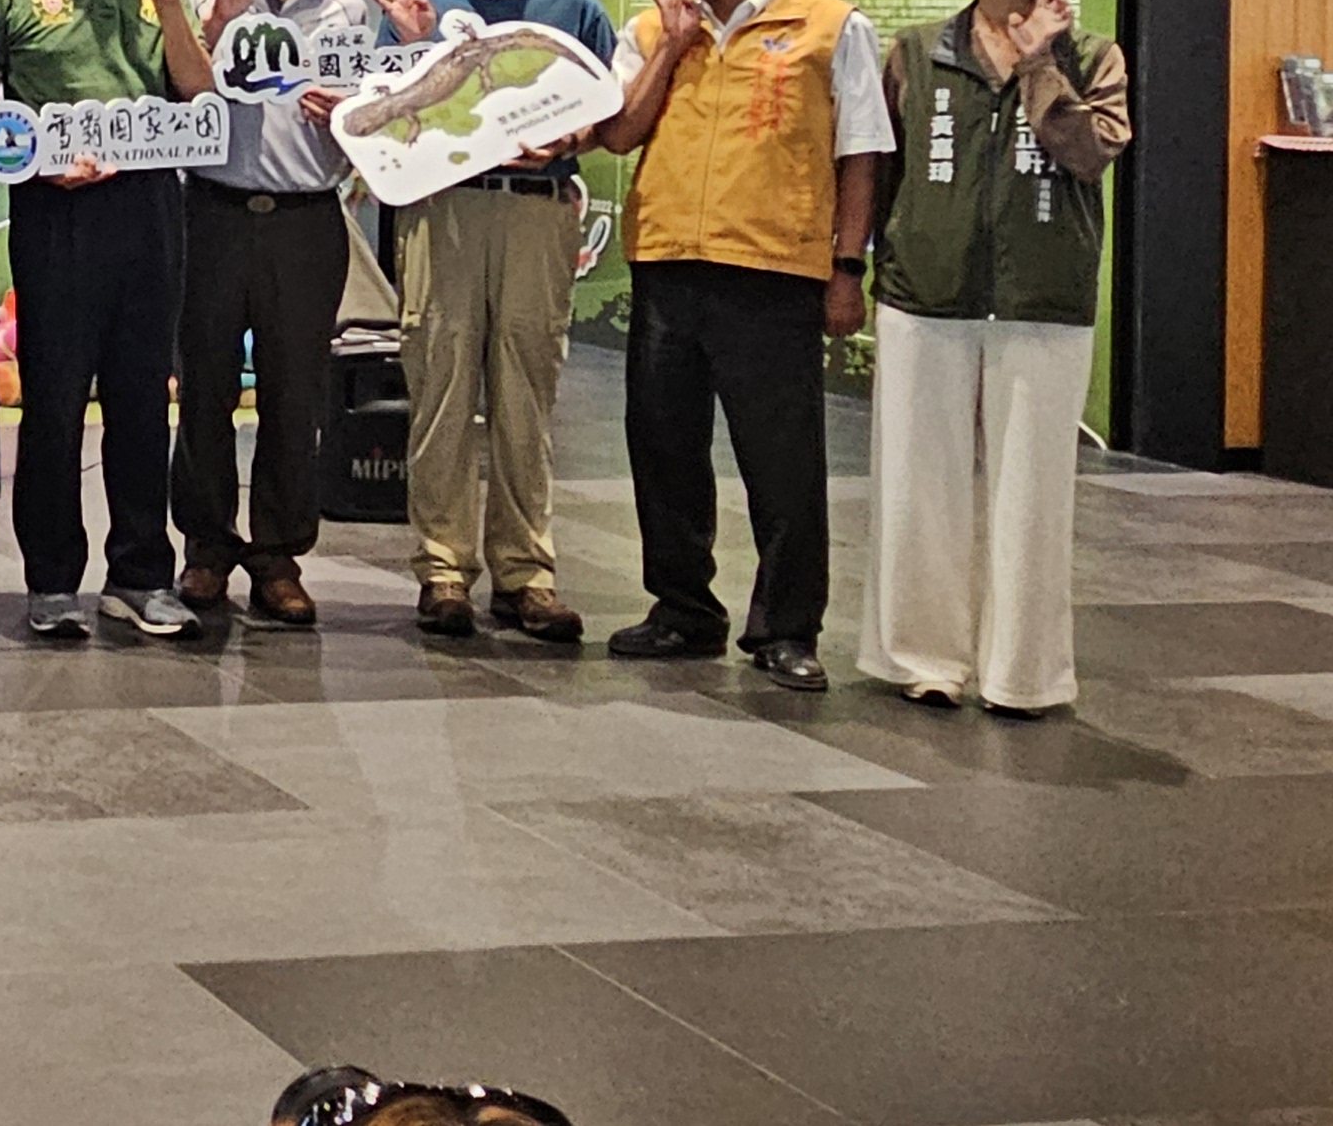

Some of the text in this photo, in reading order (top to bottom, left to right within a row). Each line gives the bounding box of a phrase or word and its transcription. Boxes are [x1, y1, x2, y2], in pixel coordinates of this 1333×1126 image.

[46, 102, 223, 151] 雪霸國家公園
[111, 144, 182, 162] NATIONAL
[185, 143, 223, 159] PARK
